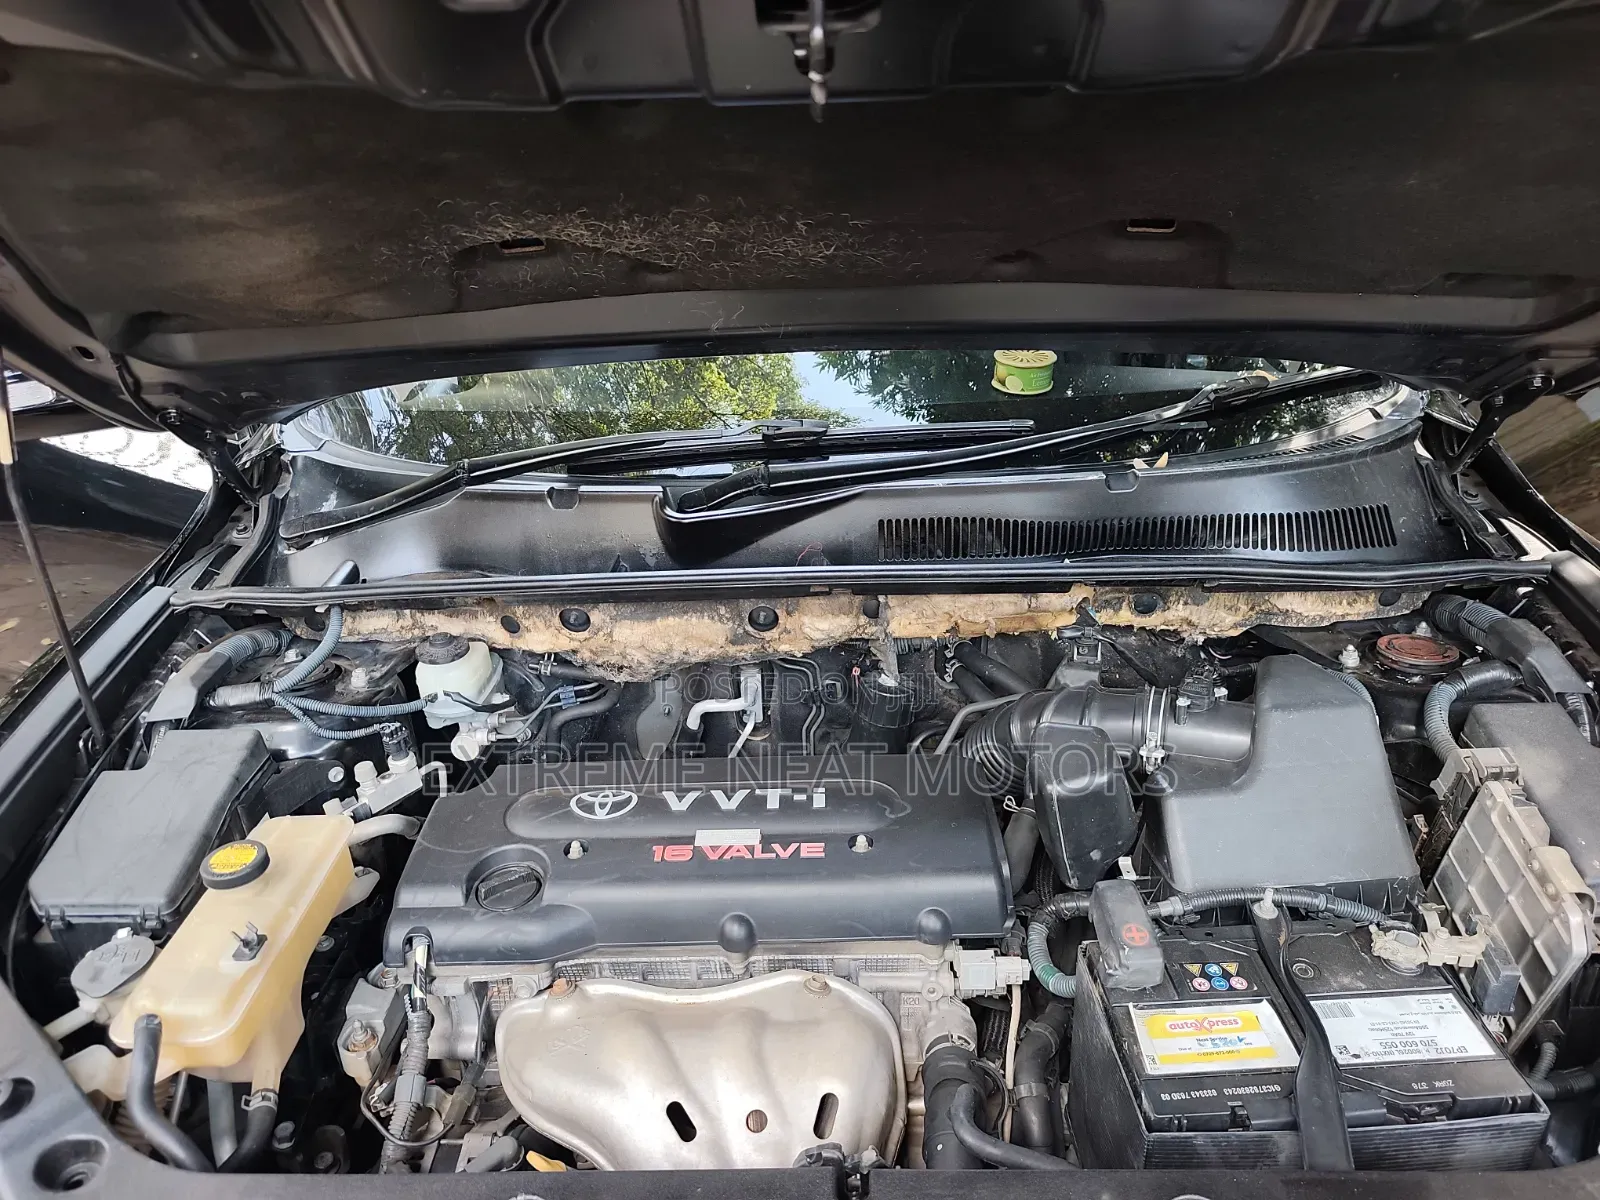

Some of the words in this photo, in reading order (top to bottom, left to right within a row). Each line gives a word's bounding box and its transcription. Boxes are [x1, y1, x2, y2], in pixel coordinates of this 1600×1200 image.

[662, 788, 826, 811] VVT-i
[652, 844, 694, 862] 16
[700, 842, 826, 860] VALVE
[1379, 1041, 1398, 1049] 055
[1398, 1040, 1418, 1048] 600
[1419, 1039, 1438, 1047] 570
